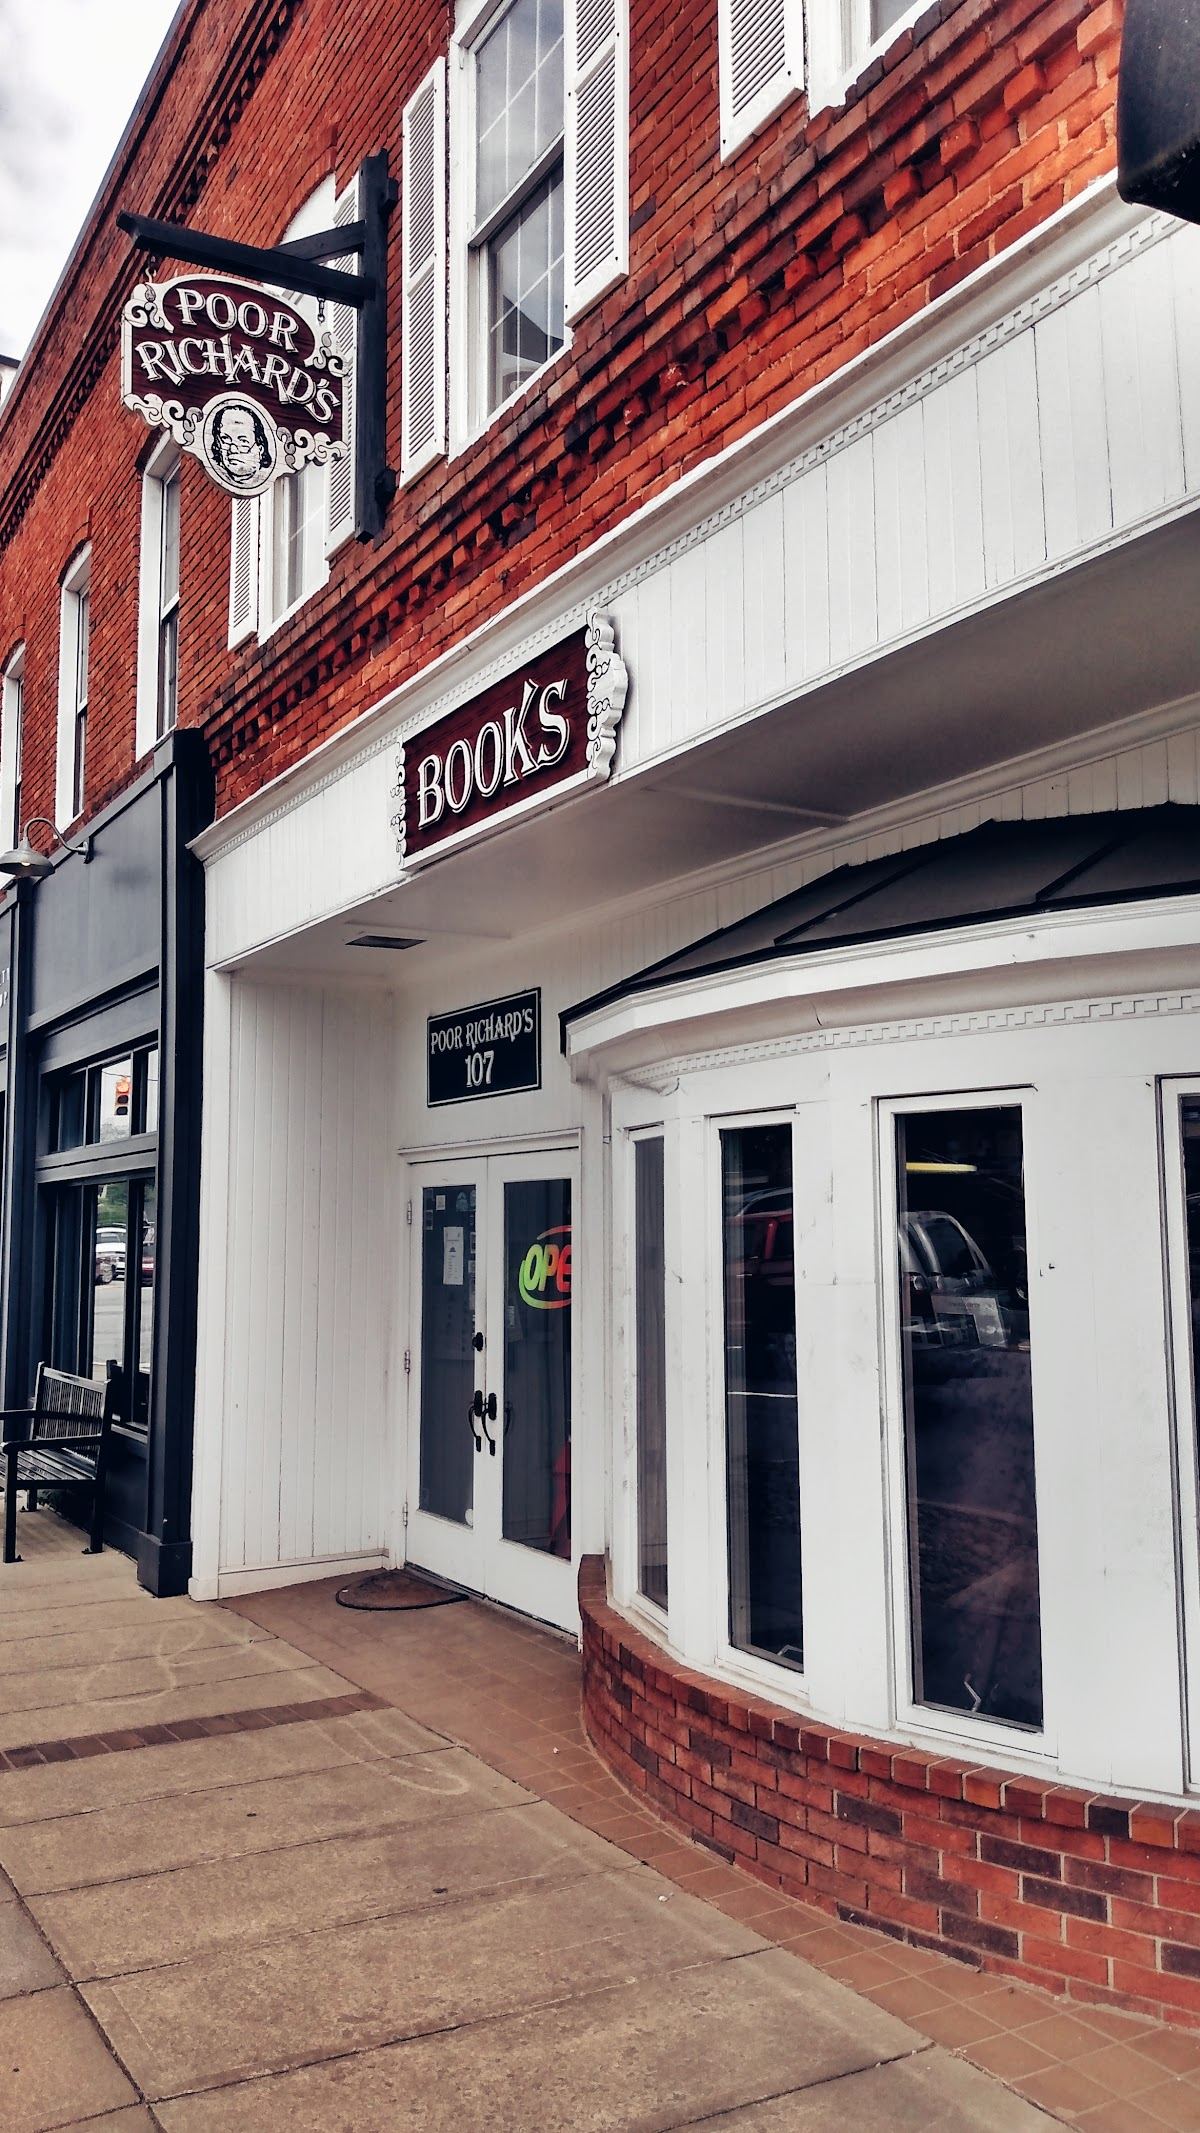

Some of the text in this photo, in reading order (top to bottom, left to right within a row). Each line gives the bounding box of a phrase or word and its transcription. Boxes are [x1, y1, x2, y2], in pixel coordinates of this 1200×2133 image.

[175, 287, 299, 353] POOR
[135, 333, 341, 424] RICHARD'S
[417, 678, 570, 830] BOOKS
[431, 1008, 534, 1055] POOR RICHARD'S
[465, 1050, 495, 1087] 107
[523, 1244, 571, 1292] OPE
